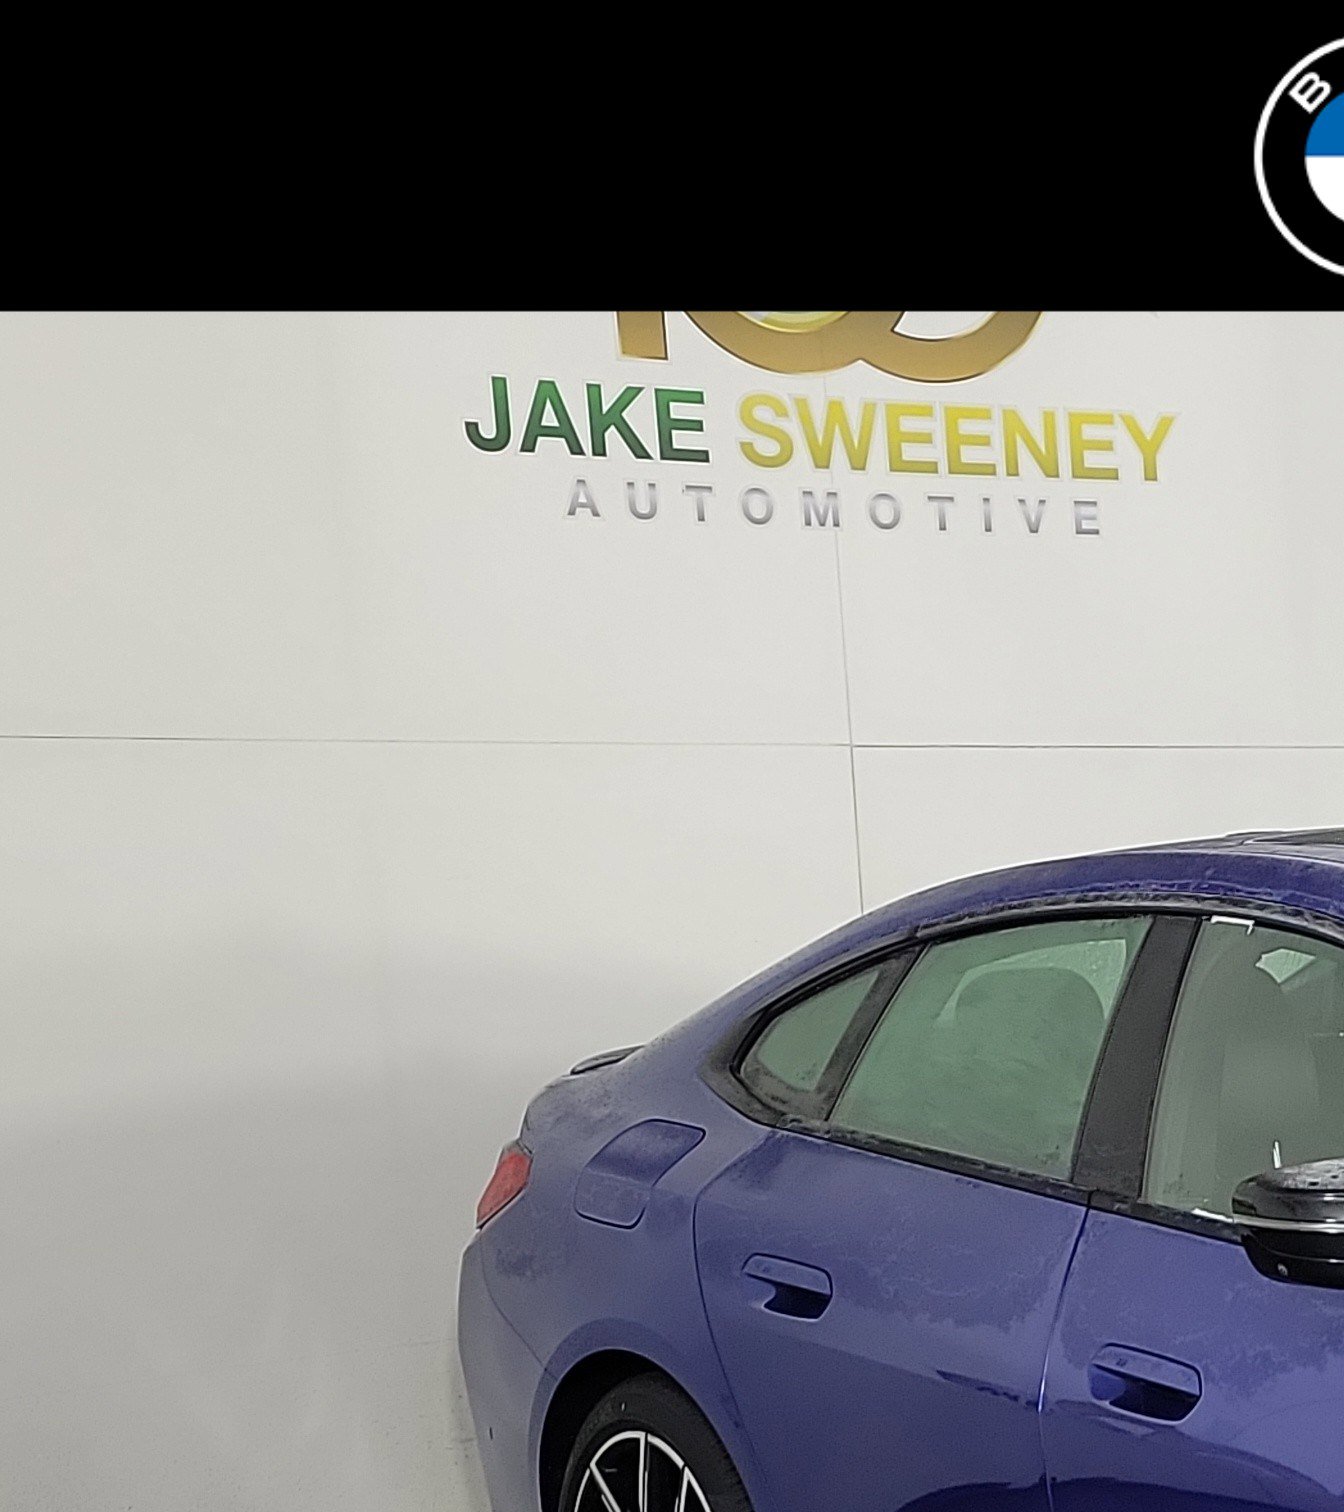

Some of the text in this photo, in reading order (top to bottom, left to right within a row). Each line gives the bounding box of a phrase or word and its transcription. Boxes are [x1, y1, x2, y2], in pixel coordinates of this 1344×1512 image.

[464, 376, 1177, 482] JAKE SWEENEY
[566, 479, 1101, 536] AUTOMOTIVE
